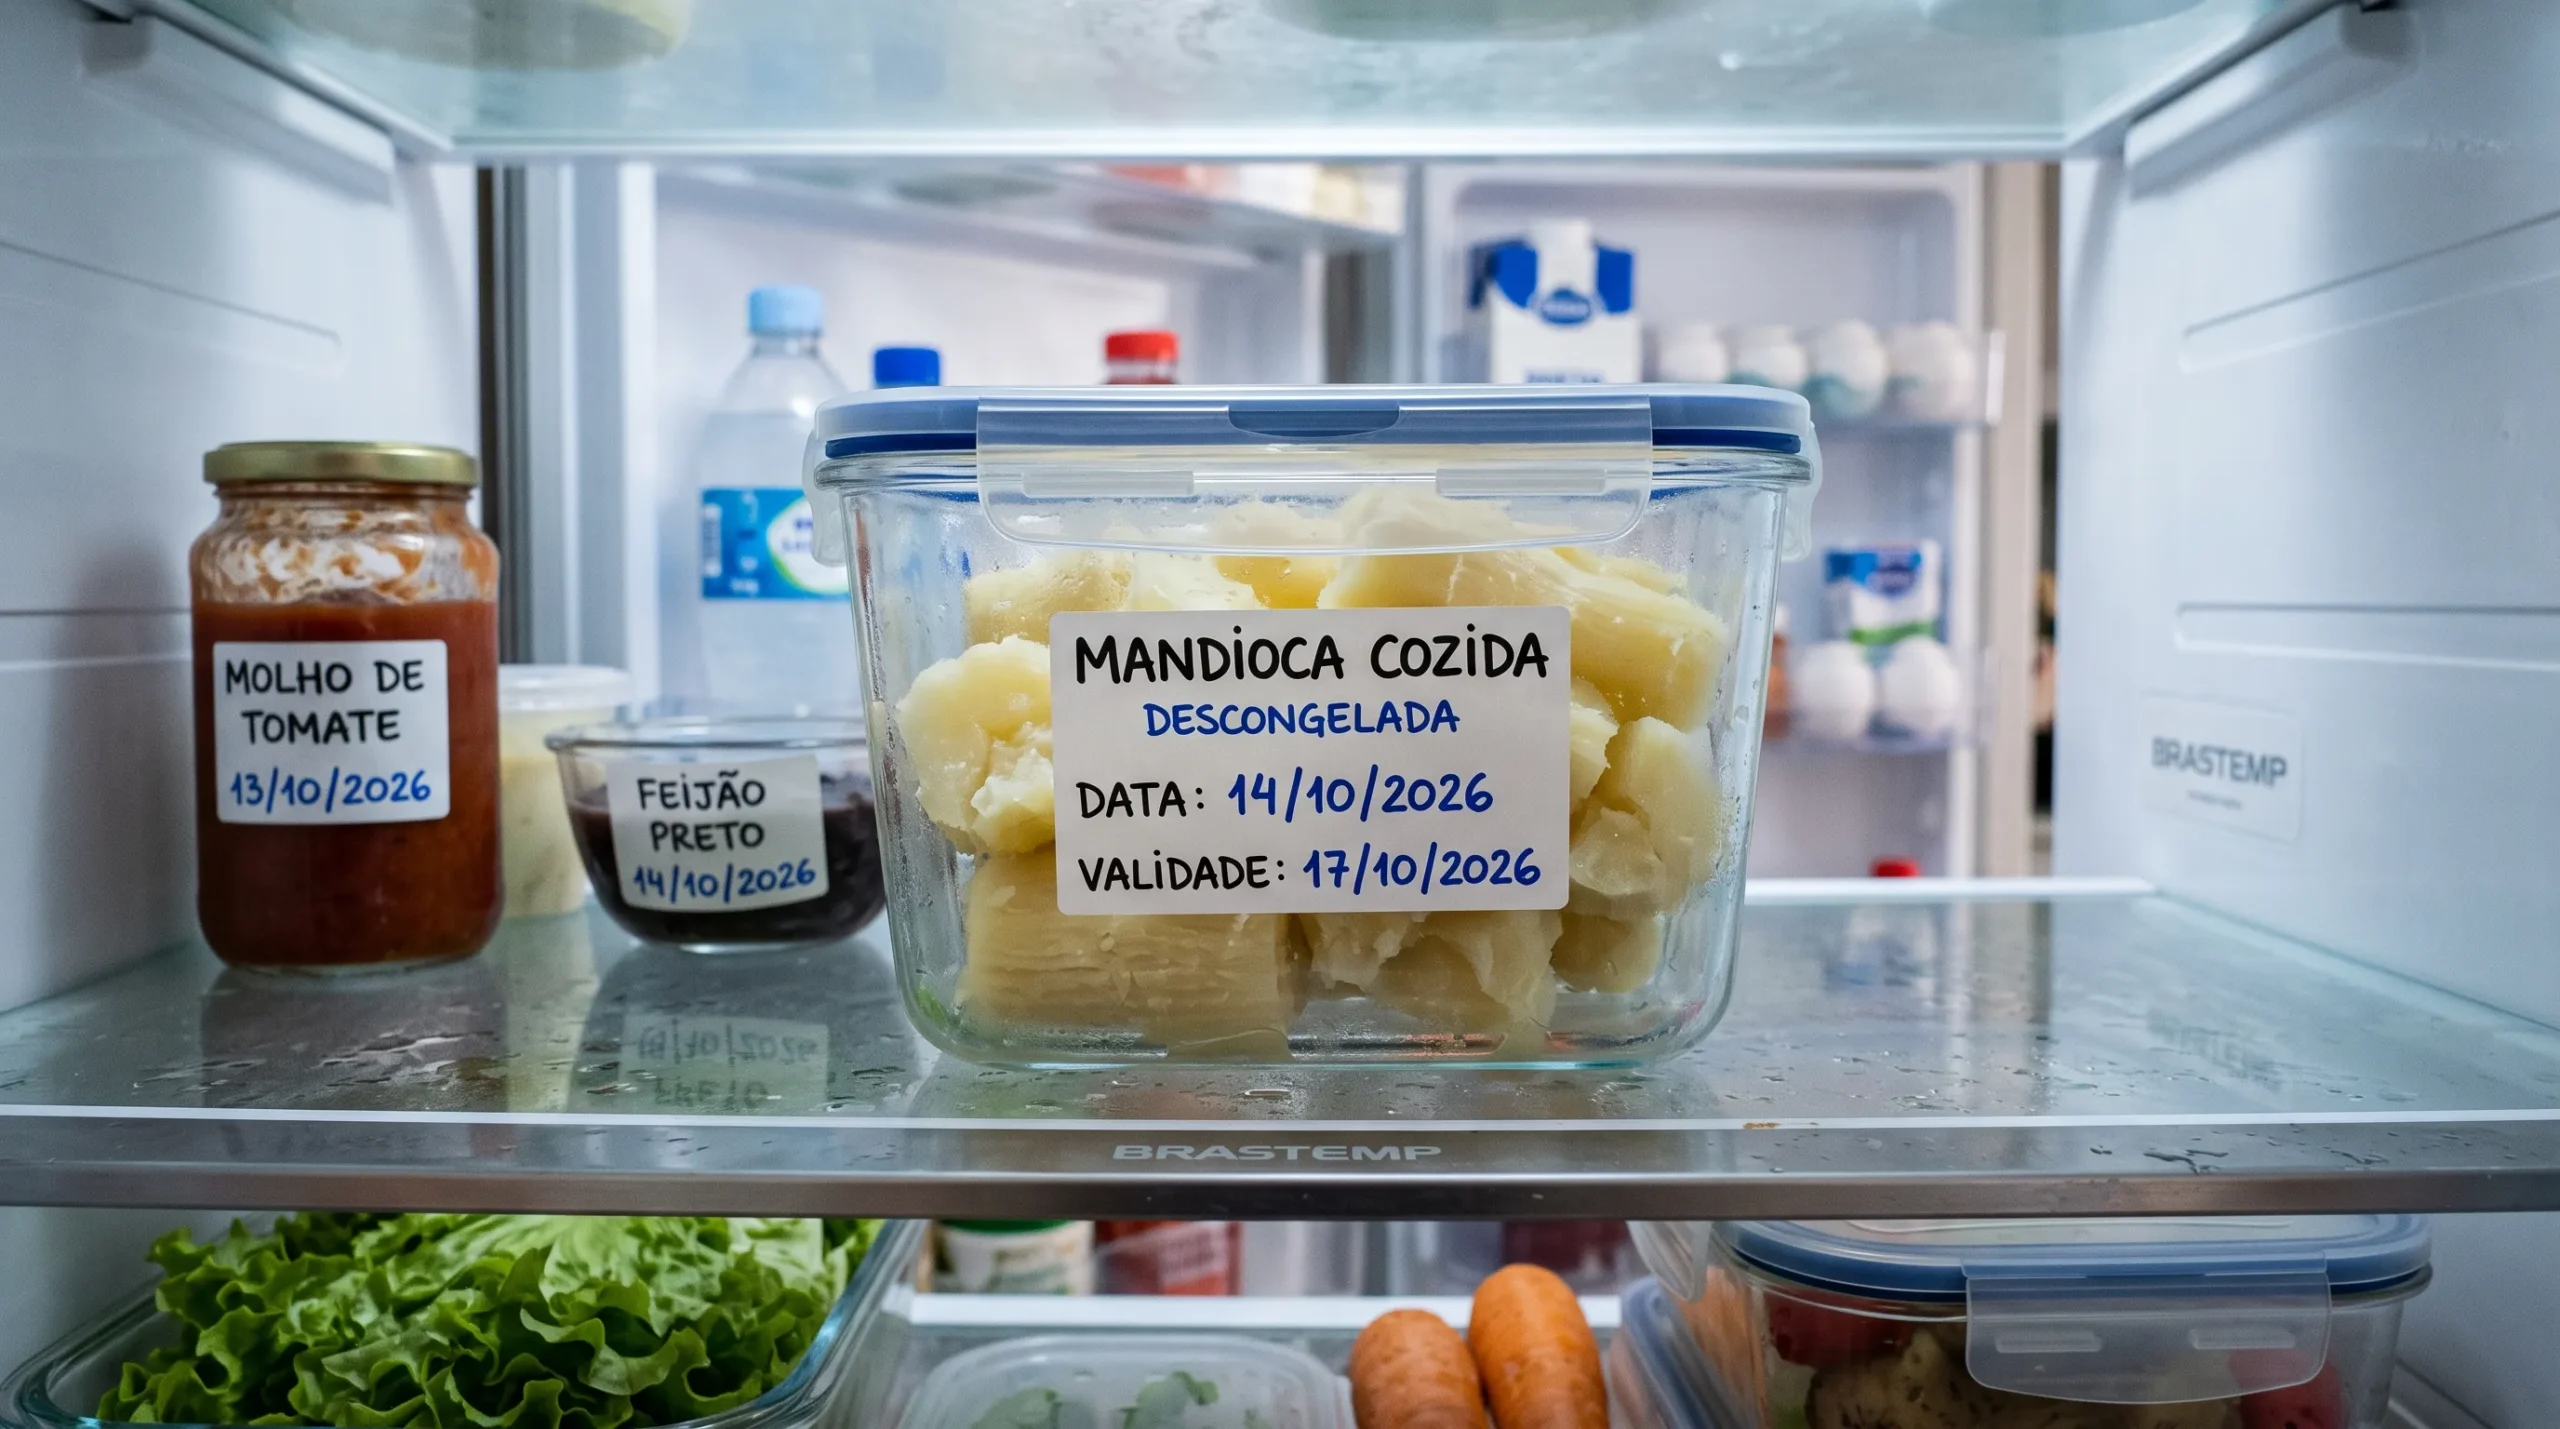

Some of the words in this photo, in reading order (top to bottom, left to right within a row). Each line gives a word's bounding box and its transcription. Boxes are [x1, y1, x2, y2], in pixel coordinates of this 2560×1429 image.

[1075, 625, 1345, 685] MANDIOCA
[1370, 622, 1550, 679] COZIDA
[225, 659, 353, 696] MOLHO
[373, 659, 424, 694] DE
[240, 709, 400, 746] TOMATE
[1142, 699, 1461, 738] DESCONGELADA
[2151, 736, 2289, 787] BRASTEMP
[229, 766, 431, 814] 13/10/2026
[636, 769, 766, 811] FEIJÃO
[1075, 780, 1205, 819] DATA:
[1227, 763, 1494, 823] 14/10/2026
[649, 820, 765, 853] PRETO
[632, 858, 816, 904] 14/10/2026
[1077, 849, 1285, 892] VALIDADE:
[1302, 841, 1541, 895] 17/10/2026
[1112, 1144, 1442, 1161] BRASTEMP
